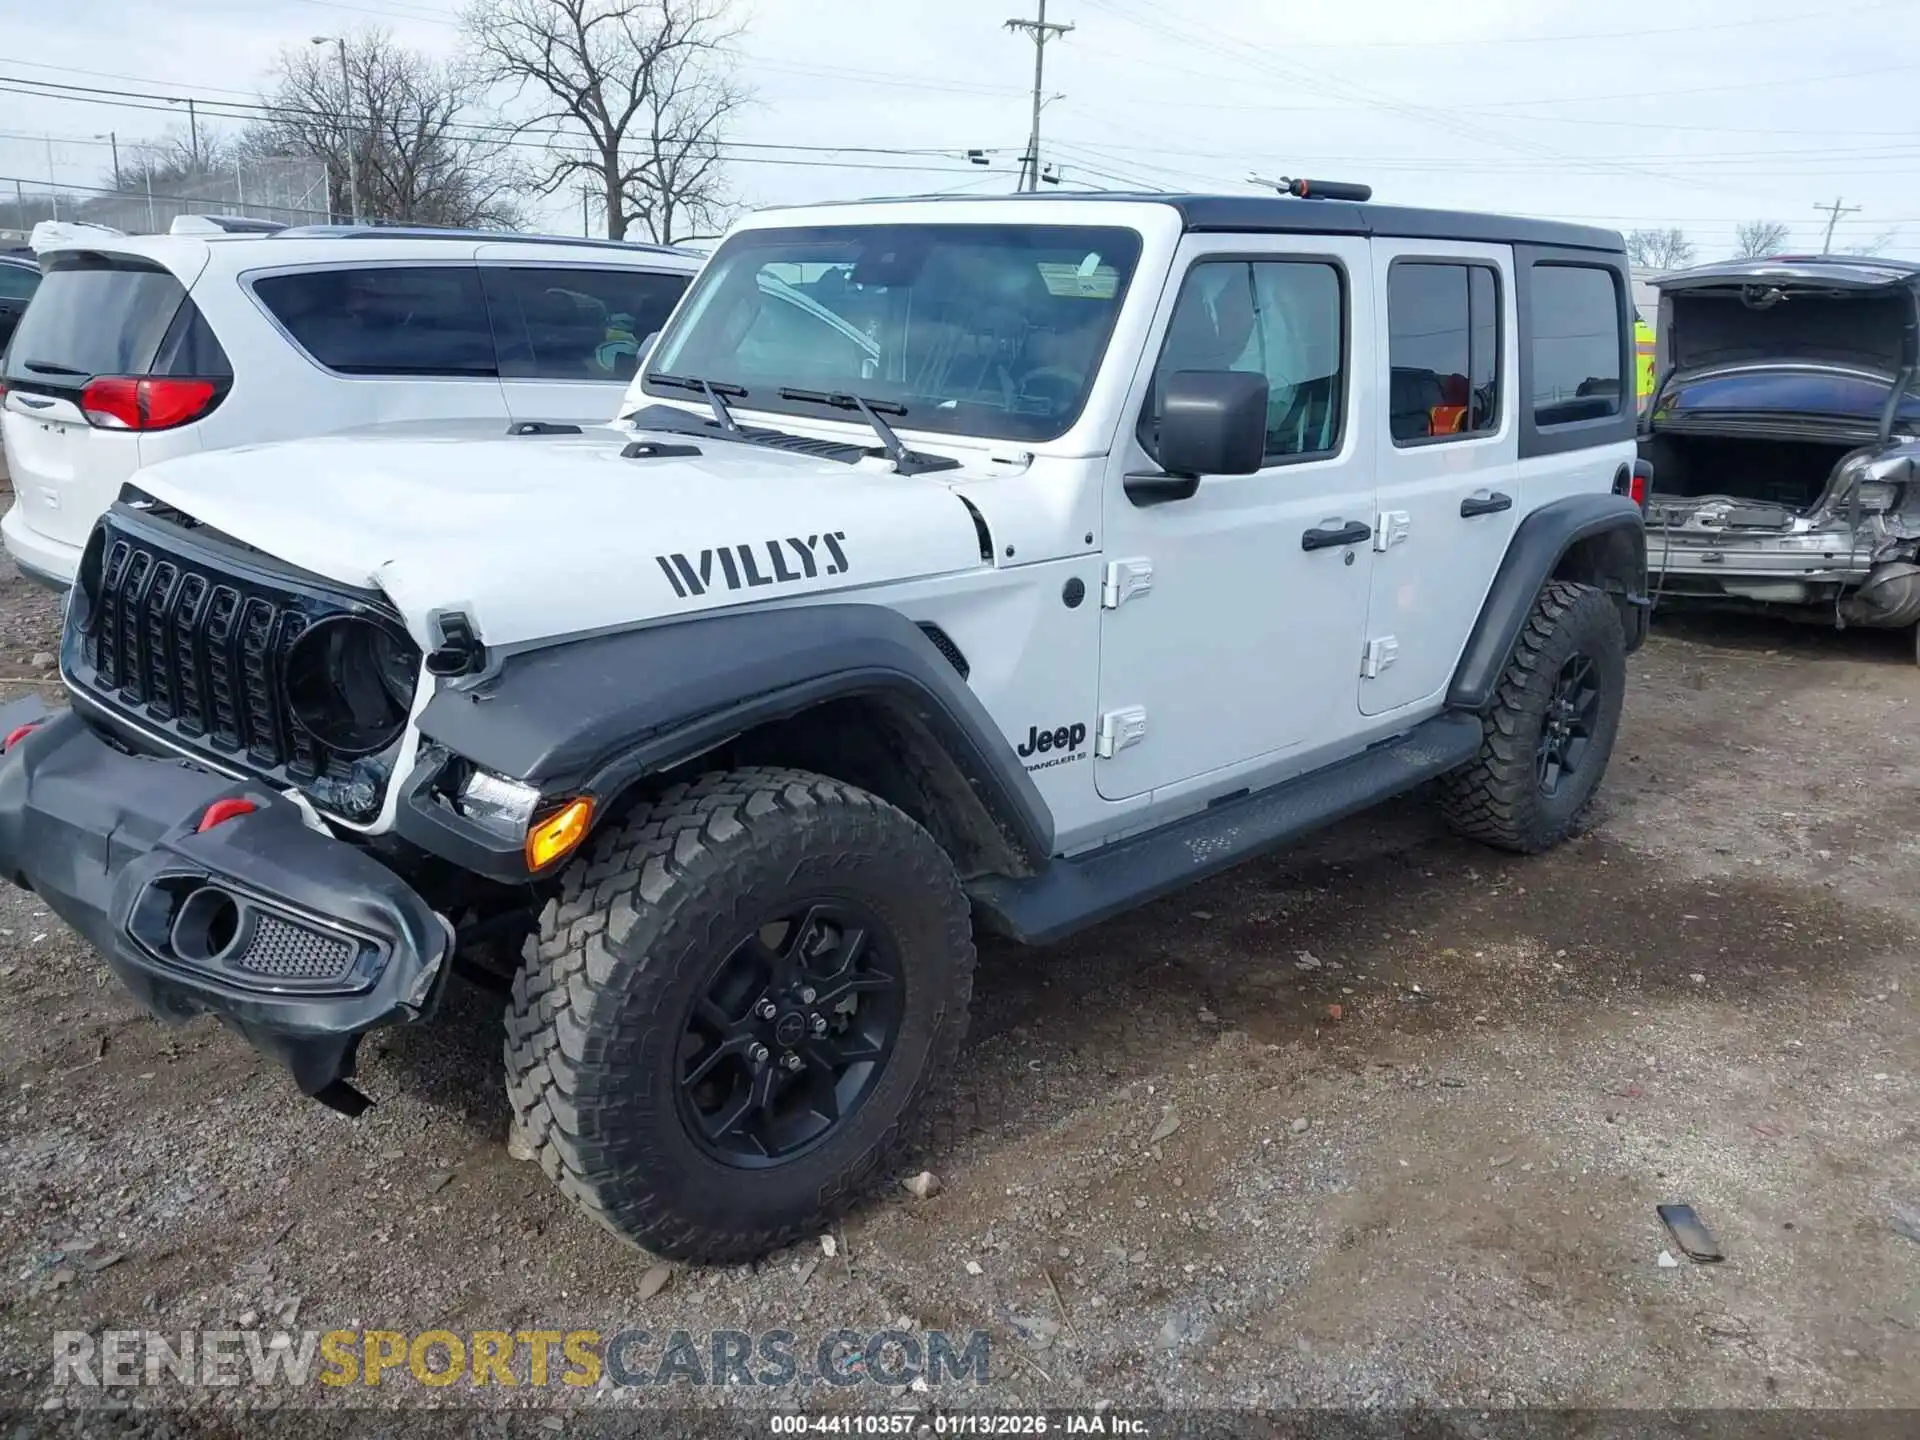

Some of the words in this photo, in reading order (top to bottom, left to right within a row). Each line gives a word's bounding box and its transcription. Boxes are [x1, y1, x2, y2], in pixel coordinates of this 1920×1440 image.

[655, 531, 849, 598] WILLYS
[1018, 722, 1086, 757] Jeep
[1025, 755, 1076, 771] RANGLER
